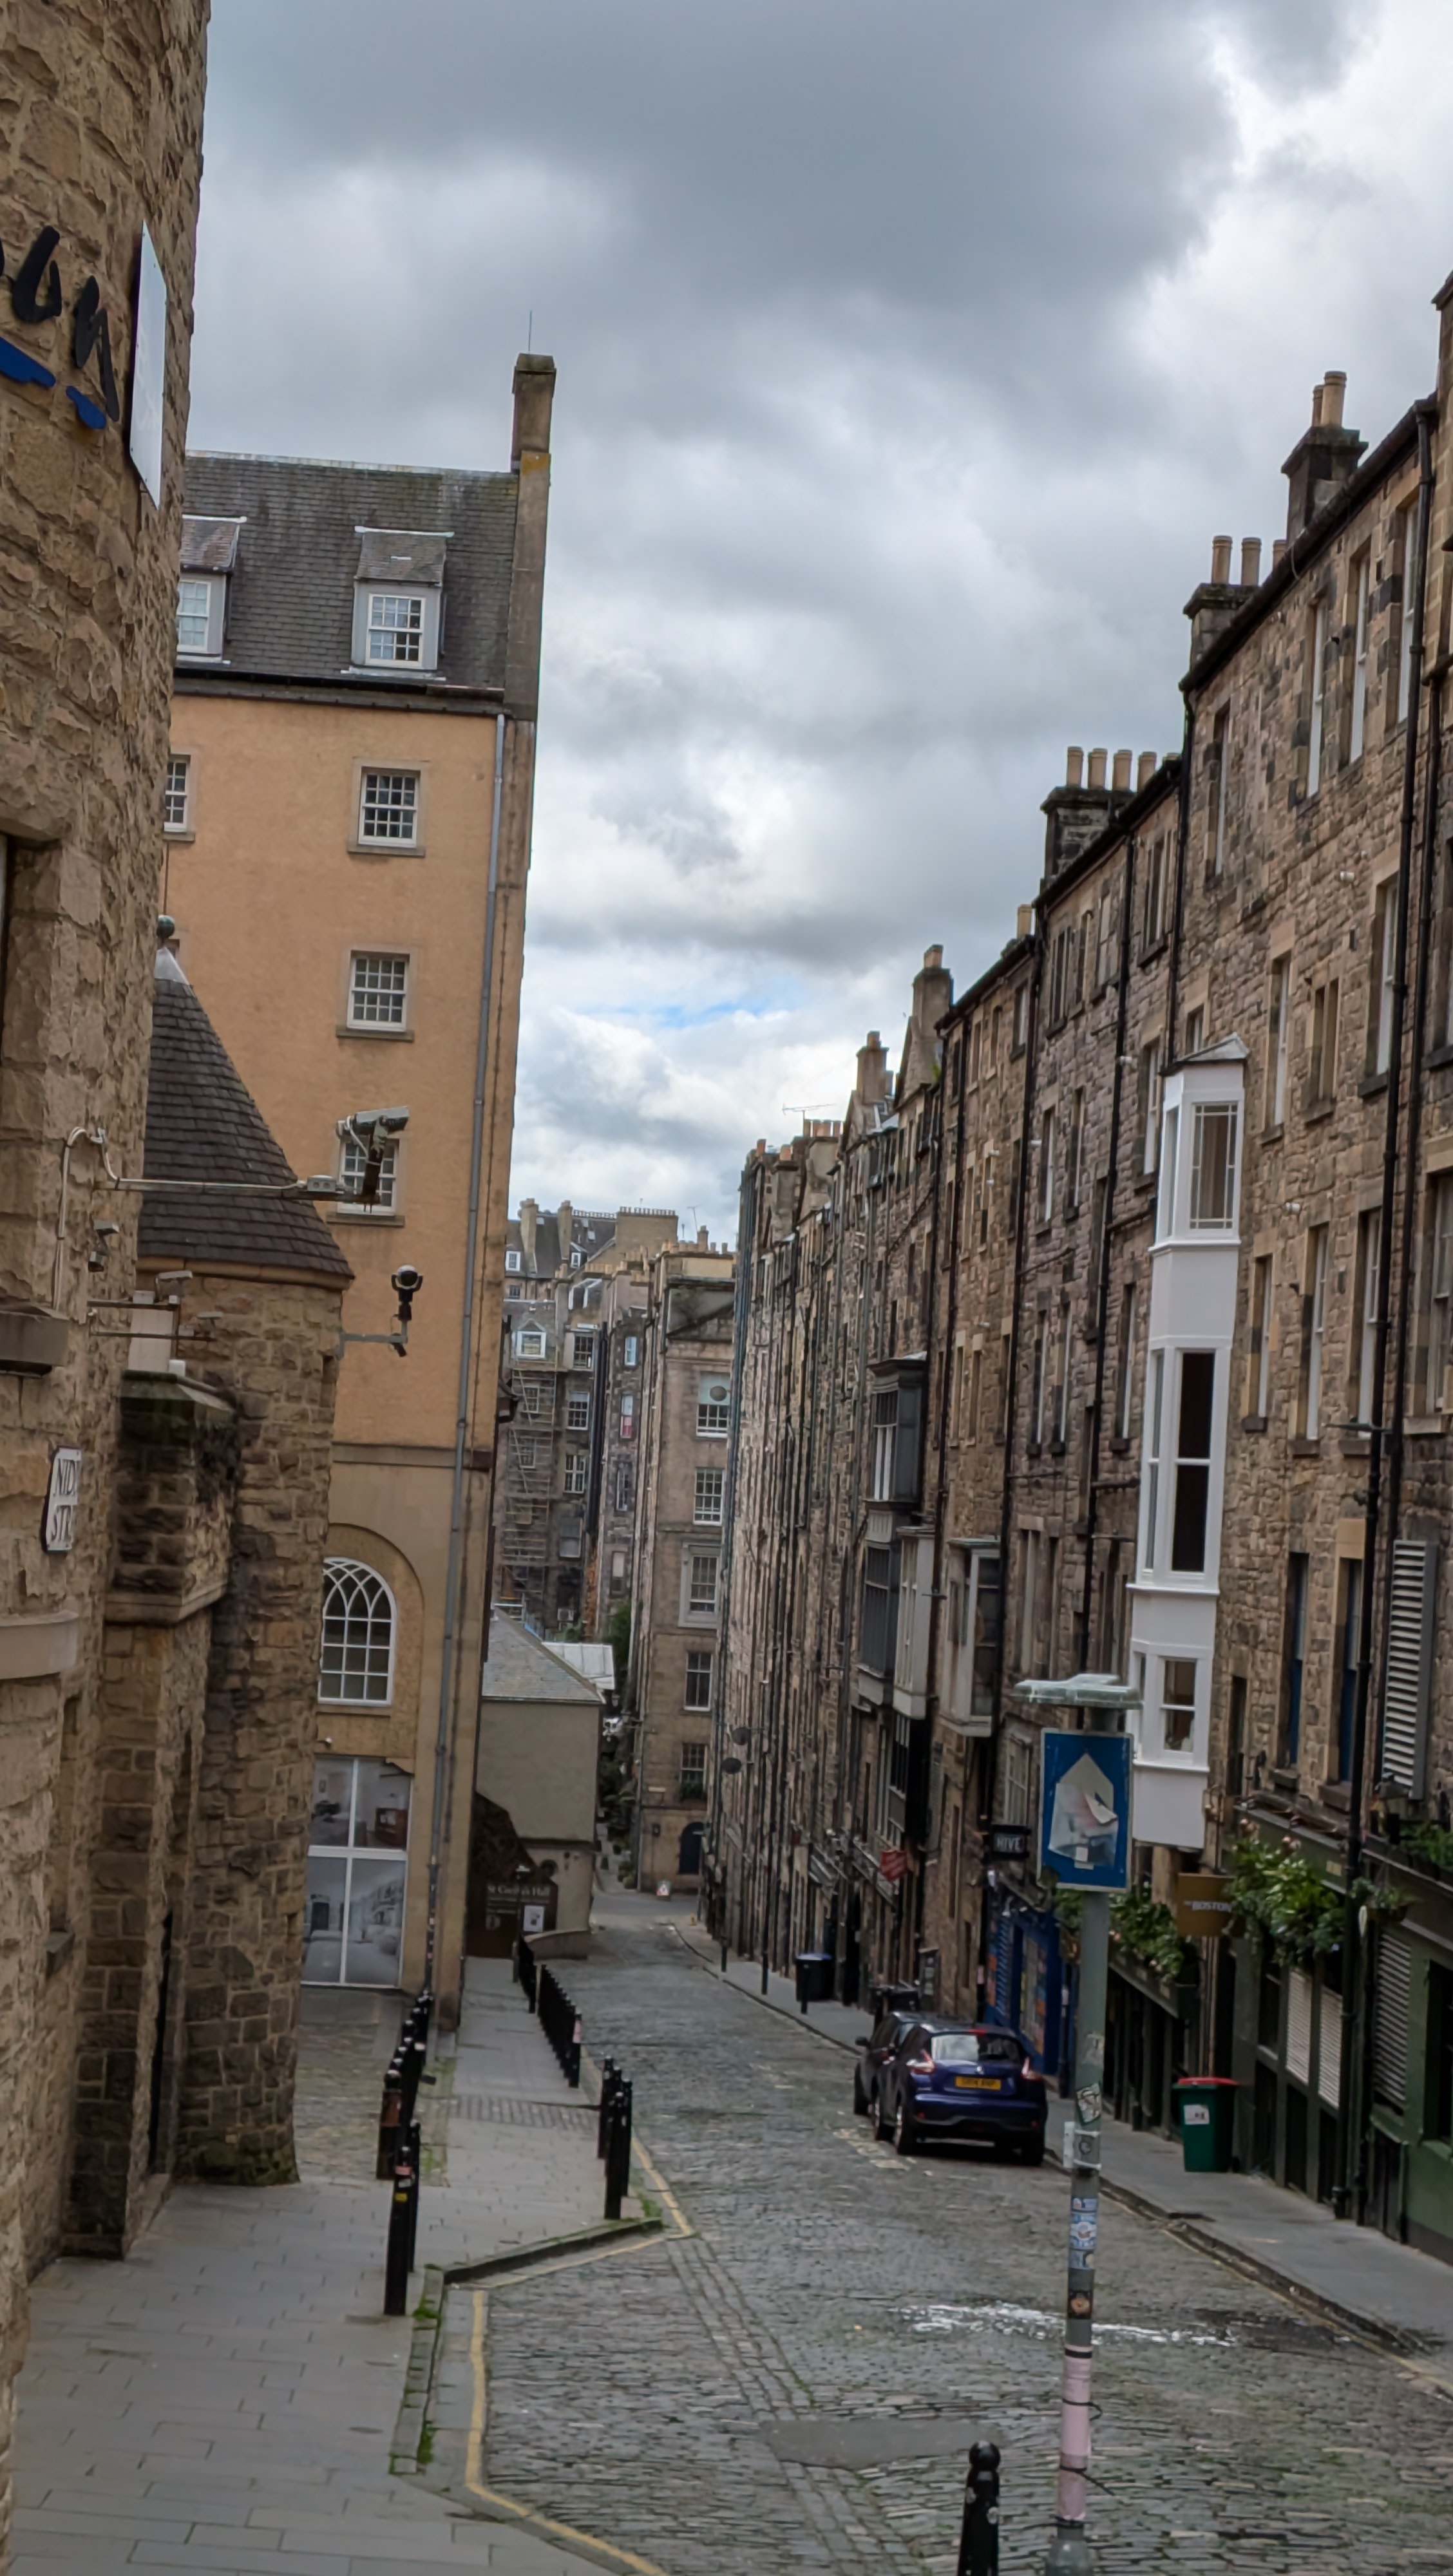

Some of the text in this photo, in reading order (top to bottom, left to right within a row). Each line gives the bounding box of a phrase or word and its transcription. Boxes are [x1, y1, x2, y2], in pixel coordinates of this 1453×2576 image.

[54, 1458, 80, 1497] NID
[996, 1837, 1020, 1851] HIVE
[532, 1886, 551, 1897] Hall
